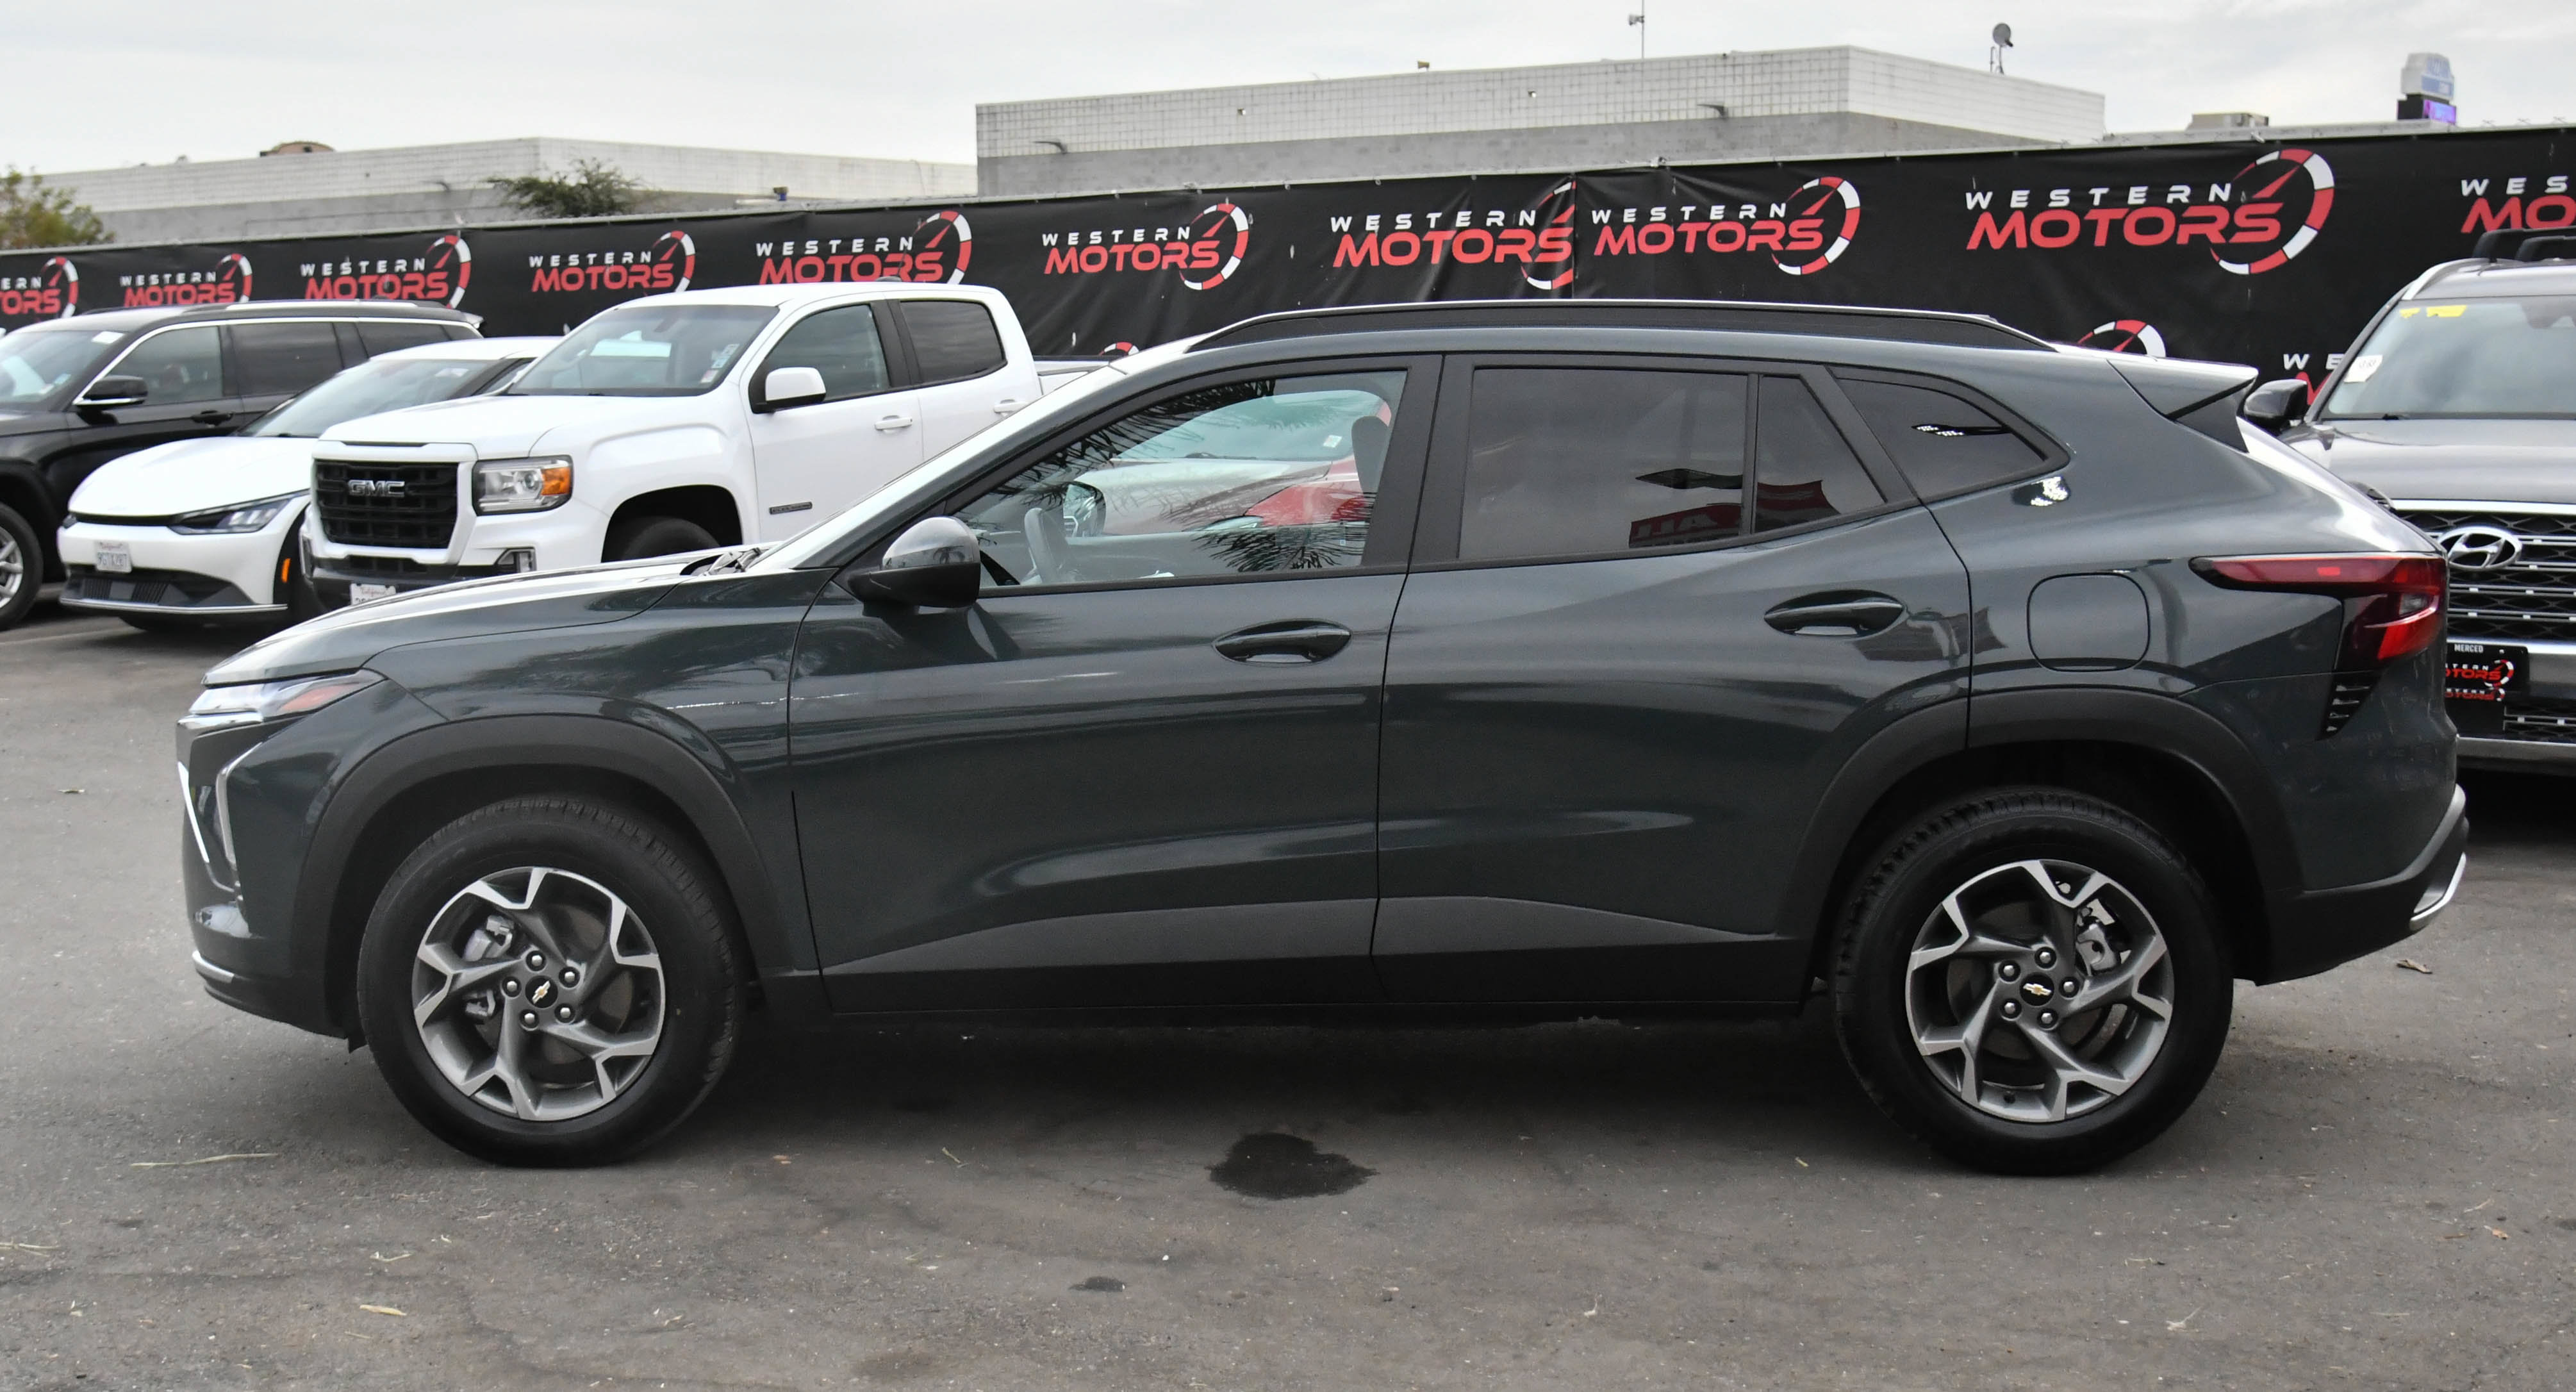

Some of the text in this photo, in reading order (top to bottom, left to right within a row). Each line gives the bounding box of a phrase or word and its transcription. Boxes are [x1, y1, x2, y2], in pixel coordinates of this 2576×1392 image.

[1966, 183, 2231, 210] WESTERN
[1330, 210, 1537, 232] WESTERN
[1592, 203, 1787, 224] WESTERN
[1966, 202, 2283, 250] MOTORS
[756, 236, 913, 256] WESTERN
[1042, 226, 1191, 246] WESTERN
[1333, 226, 1573, 267] MOTORS
[1594, 218, 1824, 256] MOTORS
[301, 258, 425, 276] WESTERN
[529, 251, 652, 268] WESTERN
[759, 251, 944, 285] MOTORS
[1044, 240, 1220, 274] MOTORS
[120, 271, 216, 286] WESTERN
[305, 271, 449, 299] MOTORS
[531, 263, 674, 293] MOTORS
[0, 288, 61, 315] ORS
[124, 282, 236, 308] MOTORS
[349, 479, 406, 497] GMC
[2454, 643, 2484, 653] MERCED
